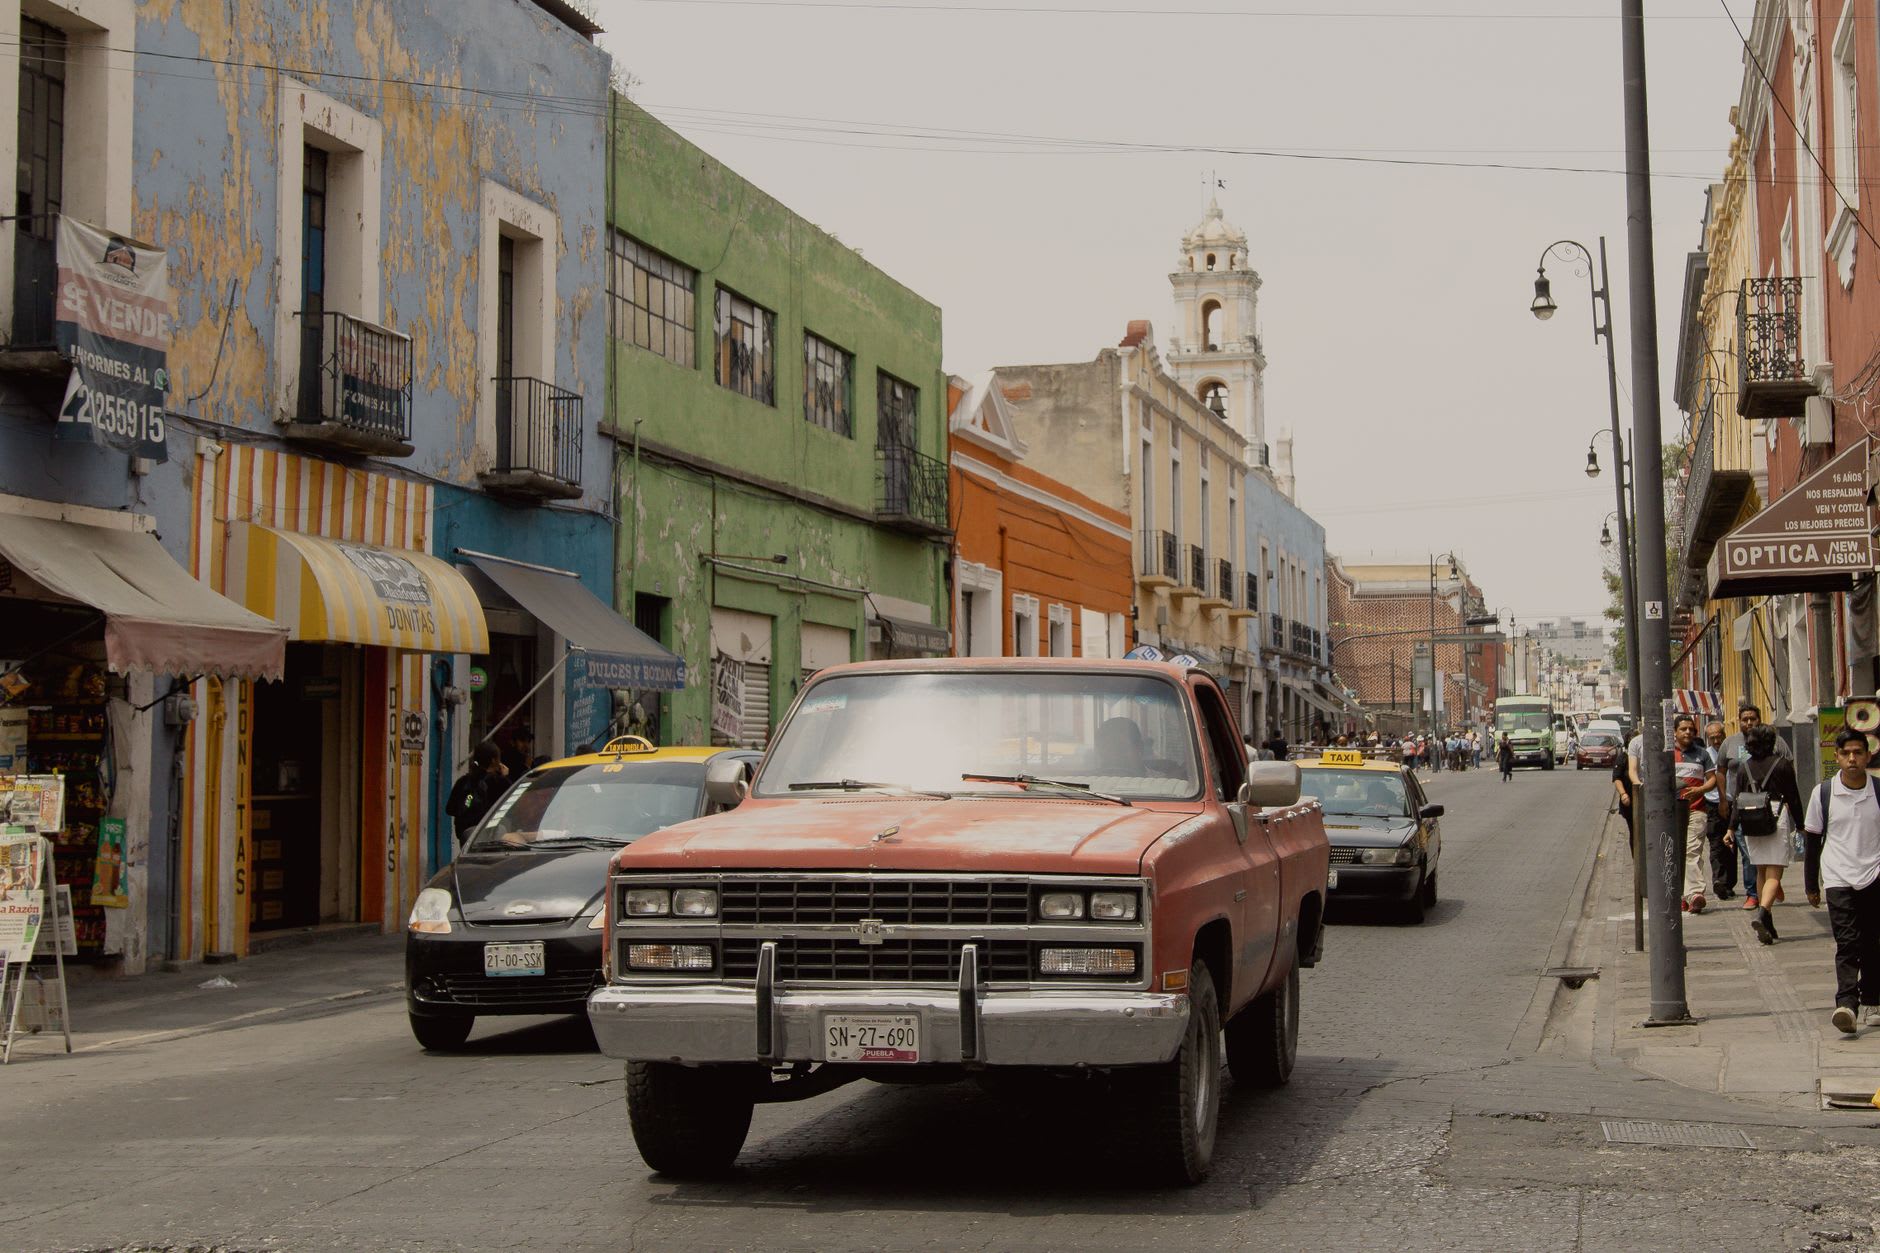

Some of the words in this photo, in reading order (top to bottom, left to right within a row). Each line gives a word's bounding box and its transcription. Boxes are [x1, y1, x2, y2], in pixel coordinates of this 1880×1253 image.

[94, 292, 168, 341] VENDE
[134, 366, 150, 385] AL
[1833, 474, 1841, 483] 16
[1842, 471, 1862, 482] AÑOS
[1806, 490, 1821, 499] NOS
[1822, 488, 1863, 498] RESPALDAN
[1815, 505, 1830, 514] VEN
[1831, 504, 1836, 513] Y
[1838, 503, 1864, 513] COTIZA
[1785, 521, 1798, 530] LOS
[1800, 519, 1833, 529] MEJORES
[1834, 517, 1865, 528] PRECIOS
[1733, 543, 1819, 566] OPTICA
[1831, 541, 1858, 552] NEW
[1823, 551, 1866, 565] VISION
[386, 605, 435, 634] DONITAS
[588, 661, 632, 678] DULCES
[633, 664, 641, 680] Y
[643, 665, 678, 682] BOTANA
[1330, 753, 1354, 762] TAXI
[235, 679, 247, 895] DONITAS
[388, 686, 397, 873] DONITAS
[9, 904, 40, 914] Razón
[829, 1026, 915, 1047] SN-27-690
